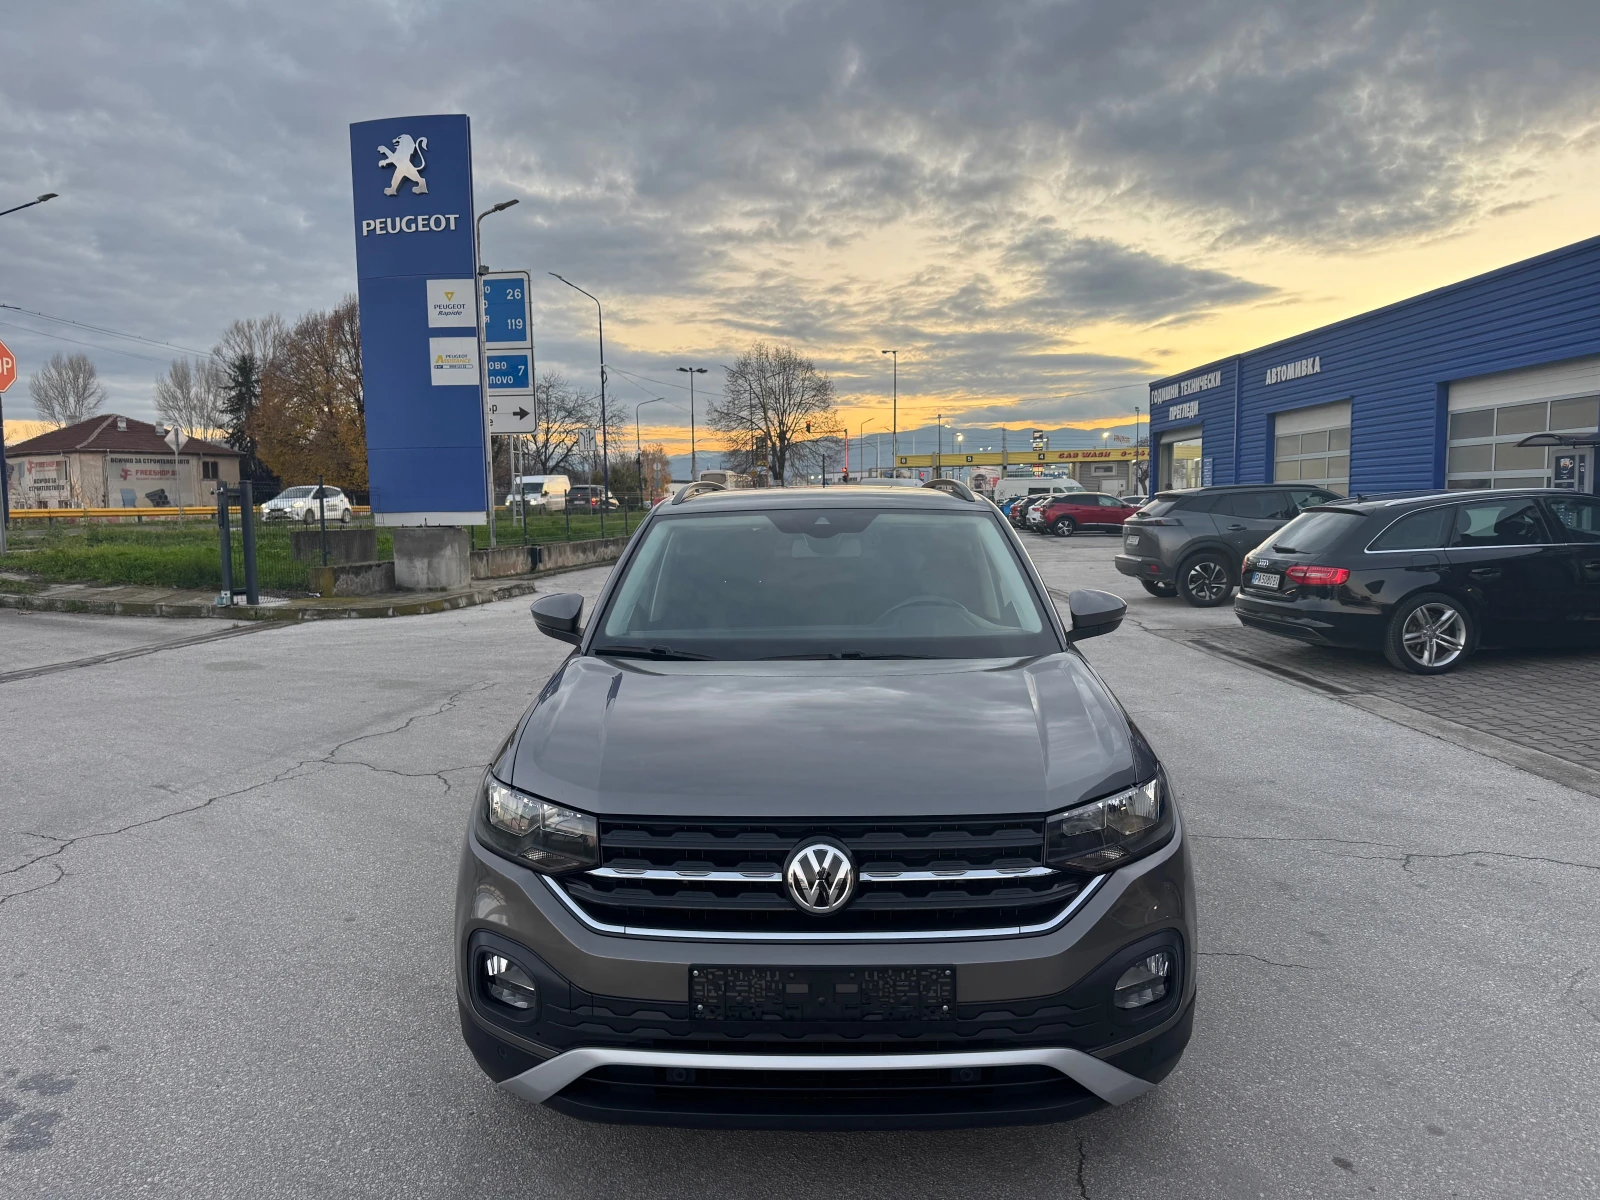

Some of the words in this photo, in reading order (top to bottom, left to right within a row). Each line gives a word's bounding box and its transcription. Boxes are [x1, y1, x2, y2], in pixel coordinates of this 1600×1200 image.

[362, 214, 460, 236] PEUGEOT
[506, 288, 522, 300] 26
[507, 318, 523, 330] 119
[518, 365, 525, 376] 7
[1265, 355, 1321, 385] АВТОМИВКА
[1151, 383, 1179, 405] ГОДИШНИ
[1180, 370, 1221, 396] ТЕХНИЧЕСКИ
[1168, 400, 1199, 421] ПРЕГЛЕДИ
